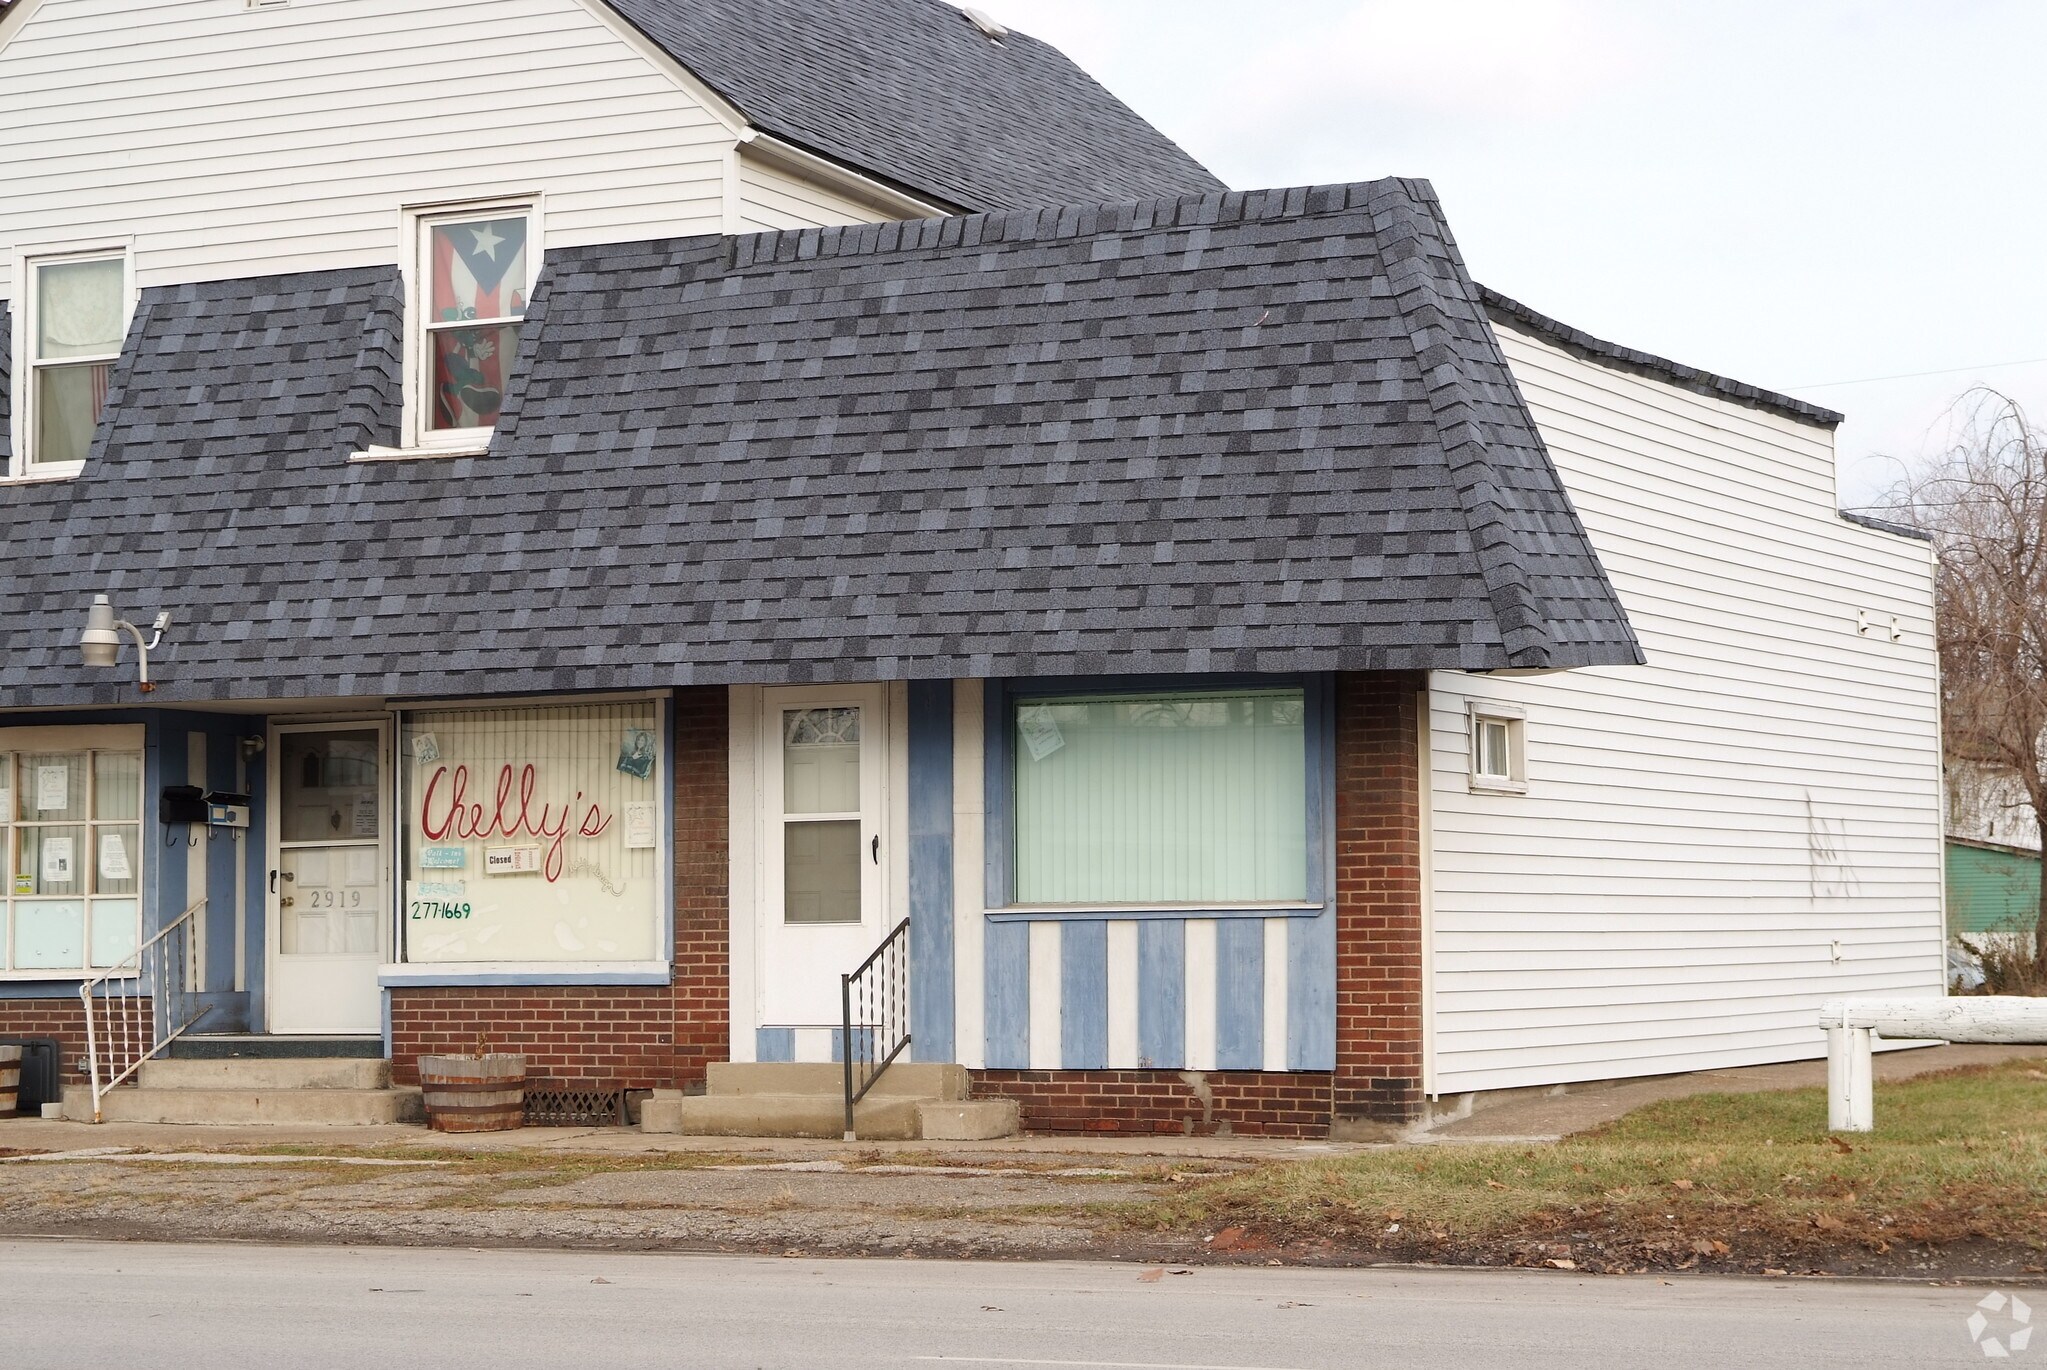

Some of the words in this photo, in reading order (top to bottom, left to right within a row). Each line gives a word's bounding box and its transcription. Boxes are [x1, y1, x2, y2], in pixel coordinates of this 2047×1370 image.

[421, 763, 613, 883] Chelly's
[489, 854, 512, 864] Closed
[311, 891, 361, 908] 2919
[411, 901, 471, 919] 277-1669
